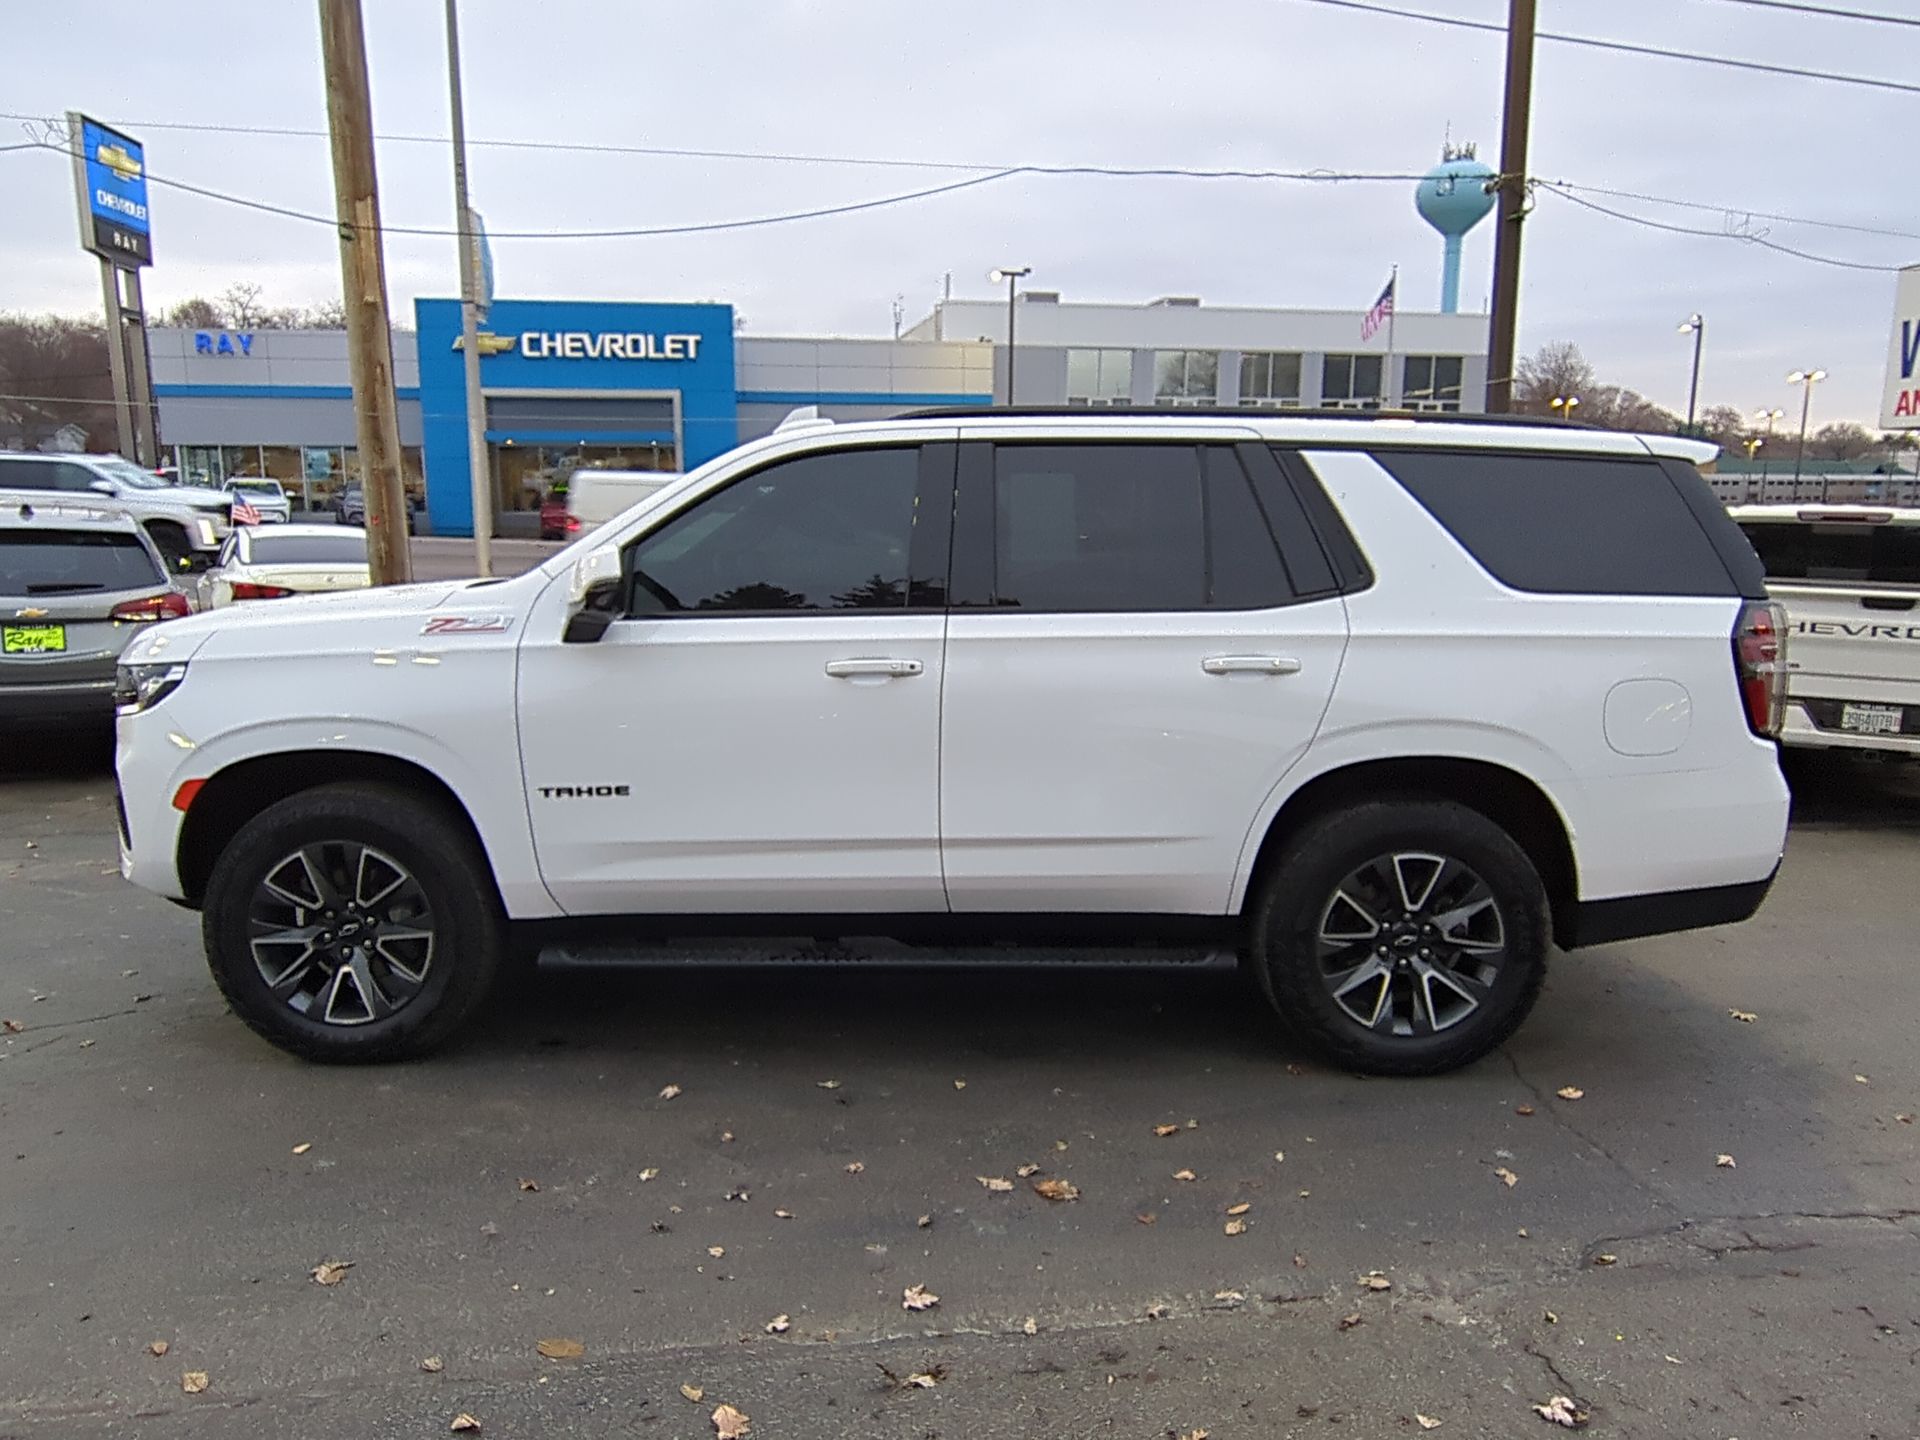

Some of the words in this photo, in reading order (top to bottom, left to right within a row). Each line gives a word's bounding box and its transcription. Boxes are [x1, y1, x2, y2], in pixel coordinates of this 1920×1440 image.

[113, 231, 138, 252] RAY
[195, 333, 254, 356] RAY
[520, 332, 702, 359] CHEVROLET
[537, 785, 630, 798] TAHOE
